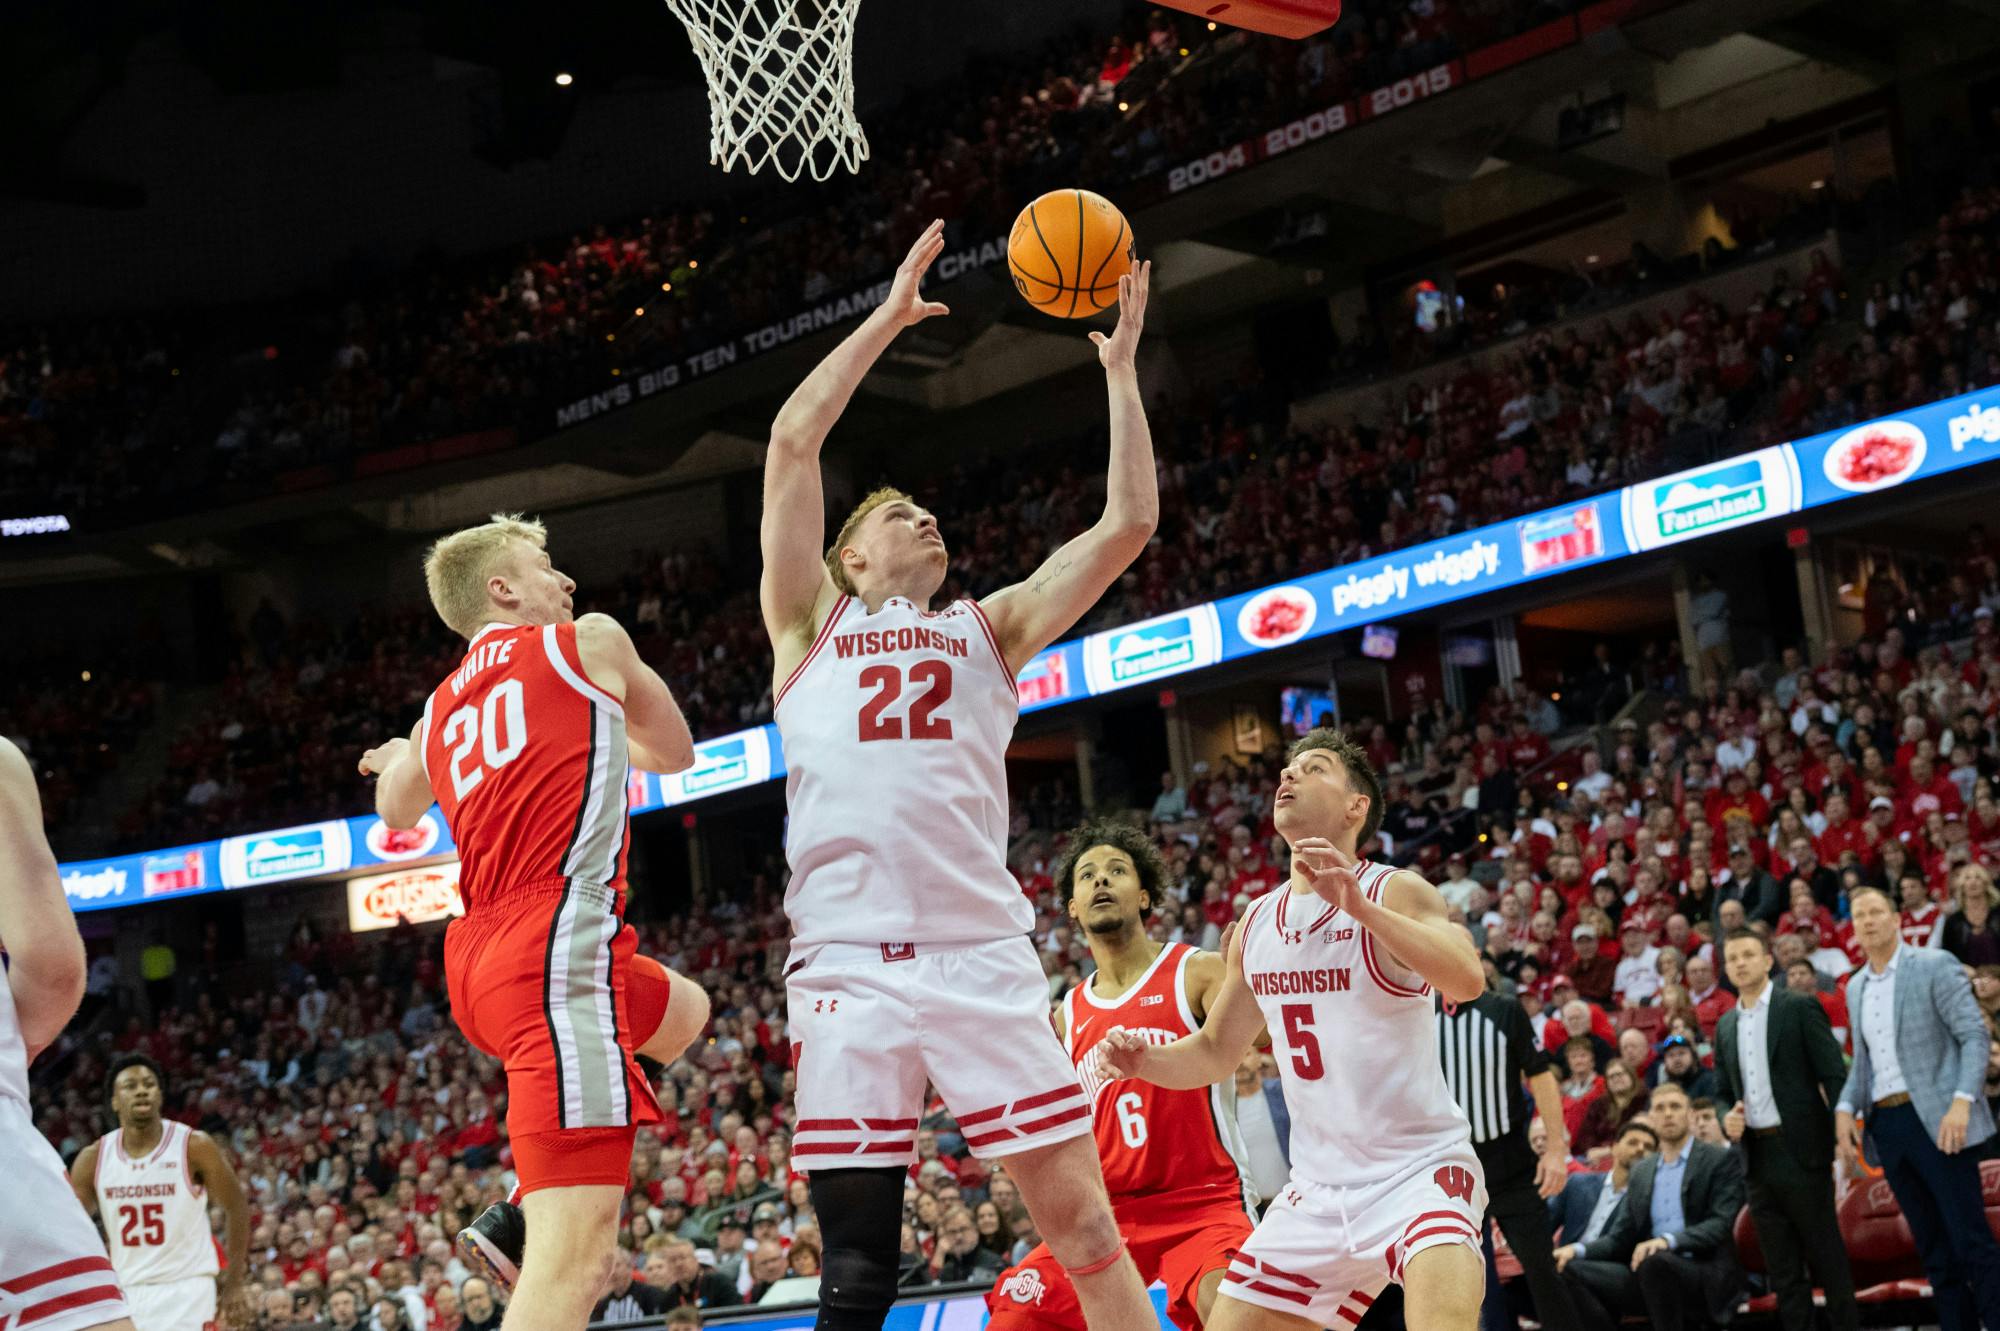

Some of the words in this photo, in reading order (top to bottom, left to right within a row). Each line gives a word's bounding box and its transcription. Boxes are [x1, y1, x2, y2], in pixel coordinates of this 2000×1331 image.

[1370, 64, 1453, 115] 2015
[1266, 105, 1347, 154] 2008
[1168, 143, 1247, 193] 2004
[556, 383, 632, 427] MEN'S
[638, 366, 680, 395] BIG
[686, 342, 737, 377] TEN
[744, 278, 893, 352] TOURNAME
[1662, 487, 1759, 533] Farmland
[1332, 565, 1410, 616] piggly
[1413, 541, 1500, 586] wiggly
[450, 638, 518, 697] WHITE
[833, 627, 968, 659] WISCONSIN
[858, 659, 953, 743] 22
[442, 678, 528, 804] 20
[1251, 967, 1352, 996] WISCONSIN
[1281, 1004, 1325, 1080] 5
[1115, 1092, 1148, 1149] 6
[104, 1183, 176, 1200] WISCONSIN
[119, 1203, 166, 1248] 25
